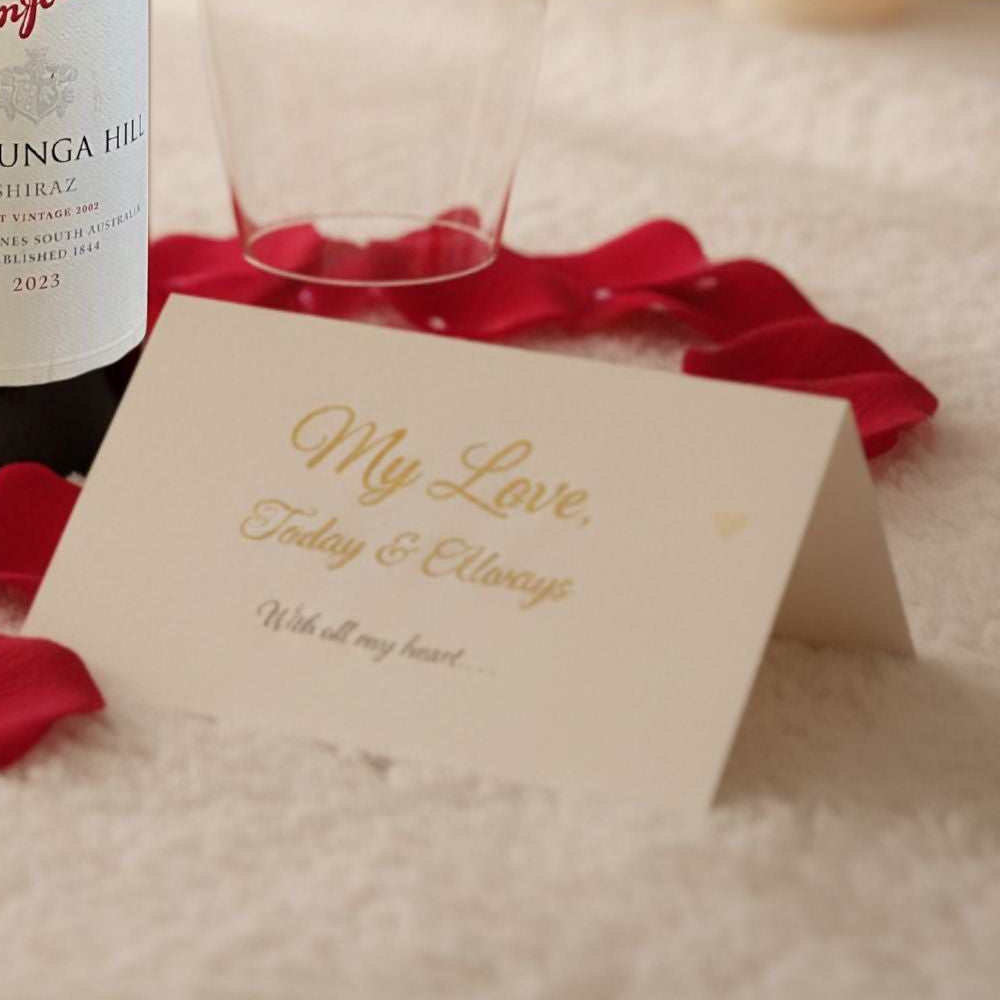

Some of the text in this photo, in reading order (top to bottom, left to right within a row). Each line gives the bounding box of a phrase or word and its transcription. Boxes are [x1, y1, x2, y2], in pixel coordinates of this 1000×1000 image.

[104, 113, 145, 153] HILL
[13, 207, 72, 222] VINTAGE
[75, 202, 100, 215] 2002
[34, 228, 83, 246] SOUTH
[88, 203, 142, 236] AUSTRALIA
[73, 241, 101, 257] 1844
[12, 273, 61, 292] 2023
[291, 404, 592, 529] My Love,
[239, 498, 367, 570] Today
[375, 531, 419, 566] &
[256, 599, 321, 637] With
[319, 619, 359, 645] all
